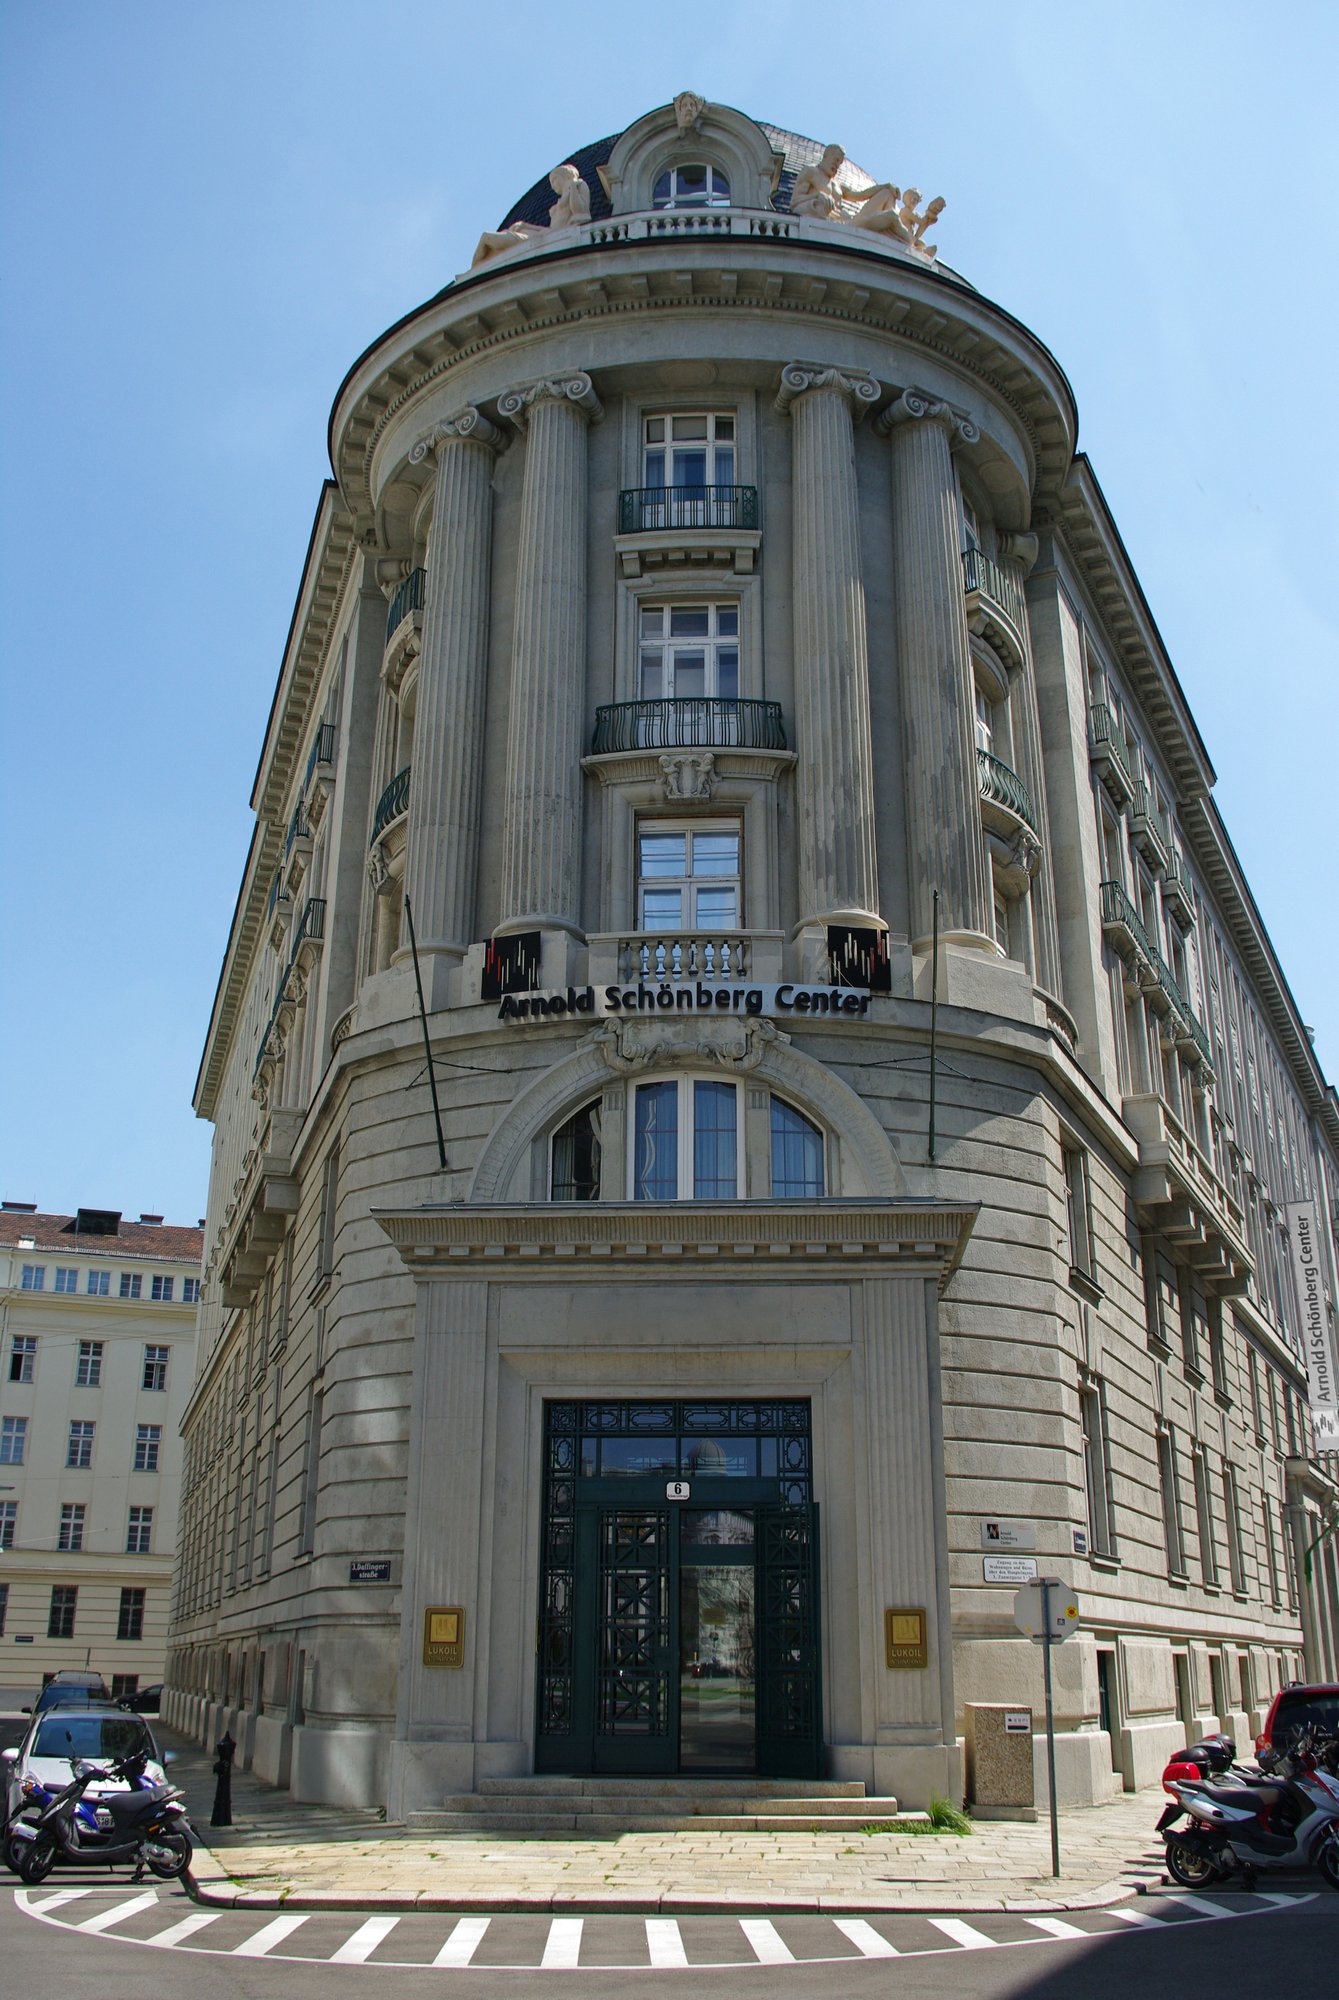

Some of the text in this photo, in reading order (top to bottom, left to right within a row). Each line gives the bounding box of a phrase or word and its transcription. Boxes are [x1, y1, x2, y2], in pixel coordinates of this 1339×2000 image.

[498, 982, 872, 1018] Arnold Schönberg Center
[1297, 1215, 1330, 1402] Arnold Schönberg Center
[674, 1483, 682, 1494] 6
[428, 1647, 457, 1655] LUKOIL
[891, 1648, 922, 1657] LUKOIL
